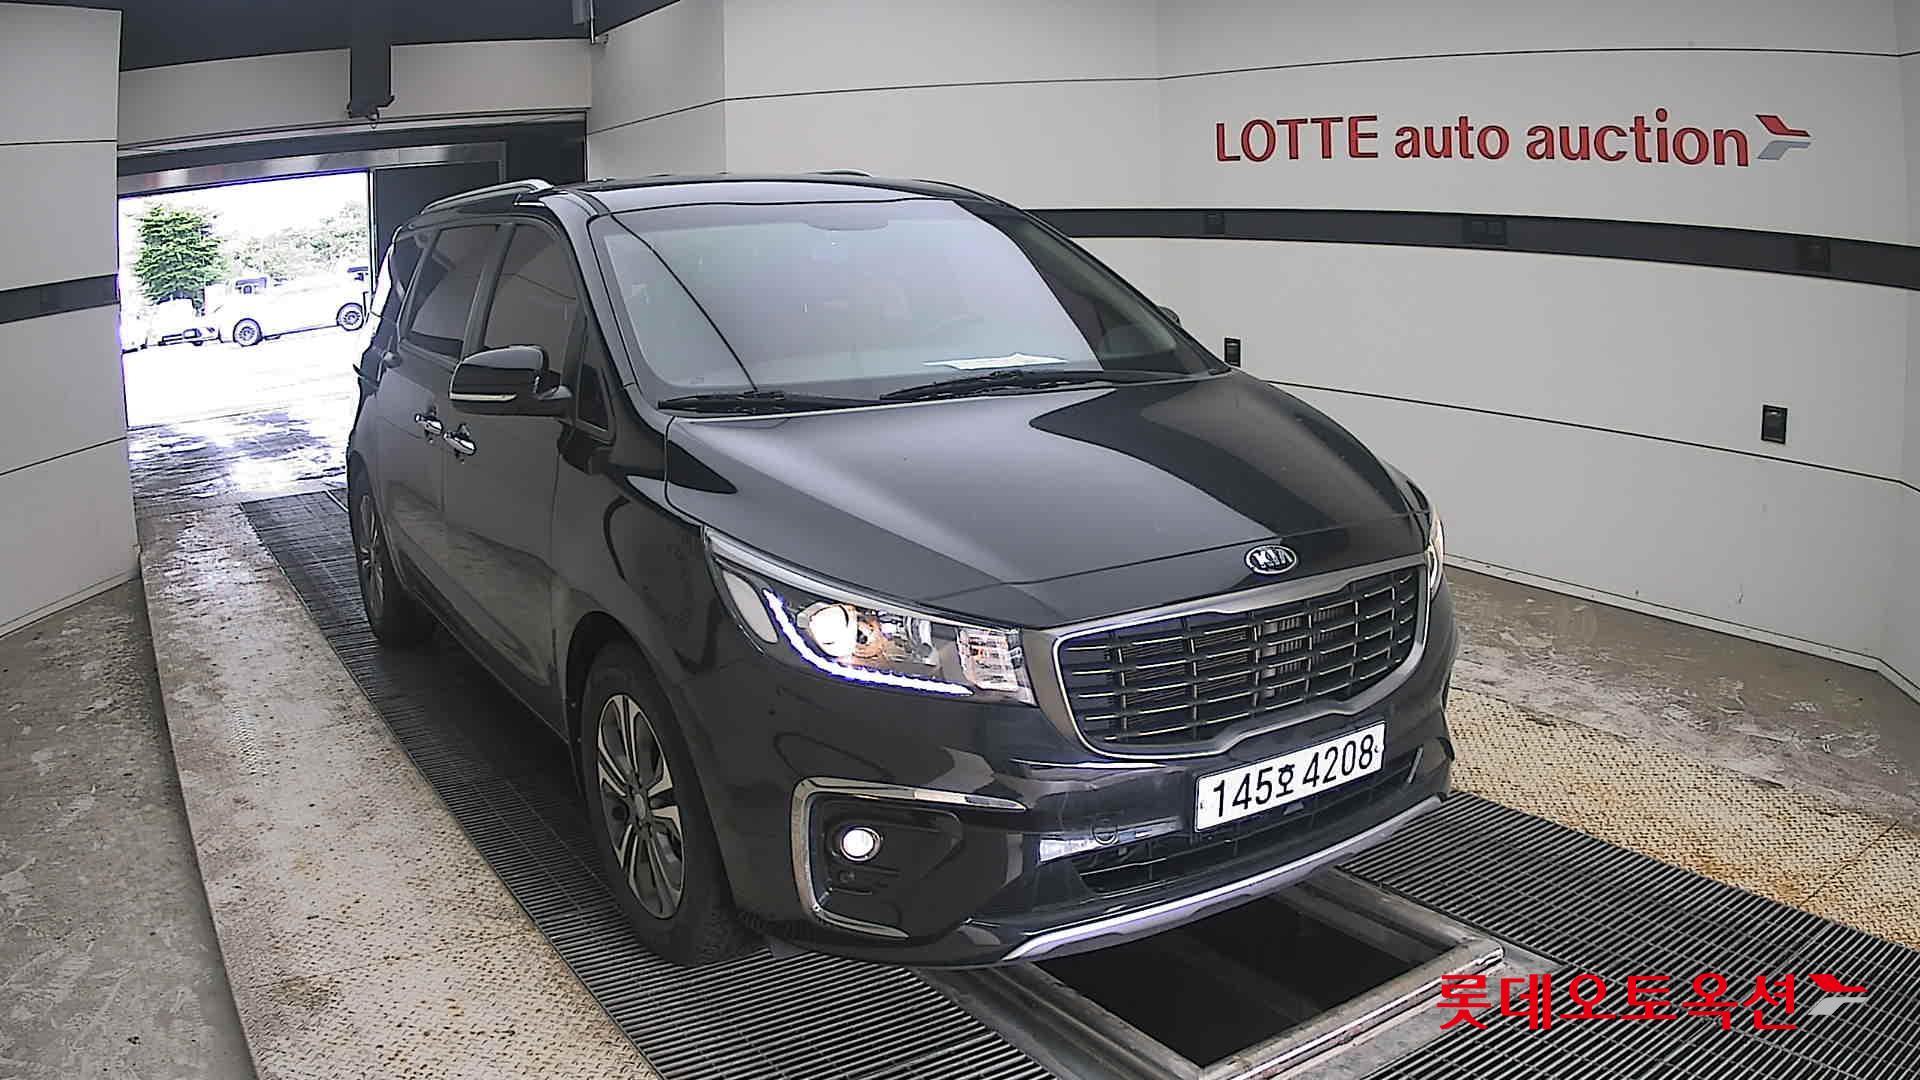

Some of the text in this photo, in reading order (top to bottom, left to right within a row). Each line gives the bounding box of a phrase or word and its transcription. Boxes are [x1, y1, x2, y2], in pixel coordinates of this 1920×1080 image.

[1216, 107, 1749, 167] LOTTE auto auction
[1249, 547, 1294, 570] KIA
[1302, 733, 1375, 788] 4208
